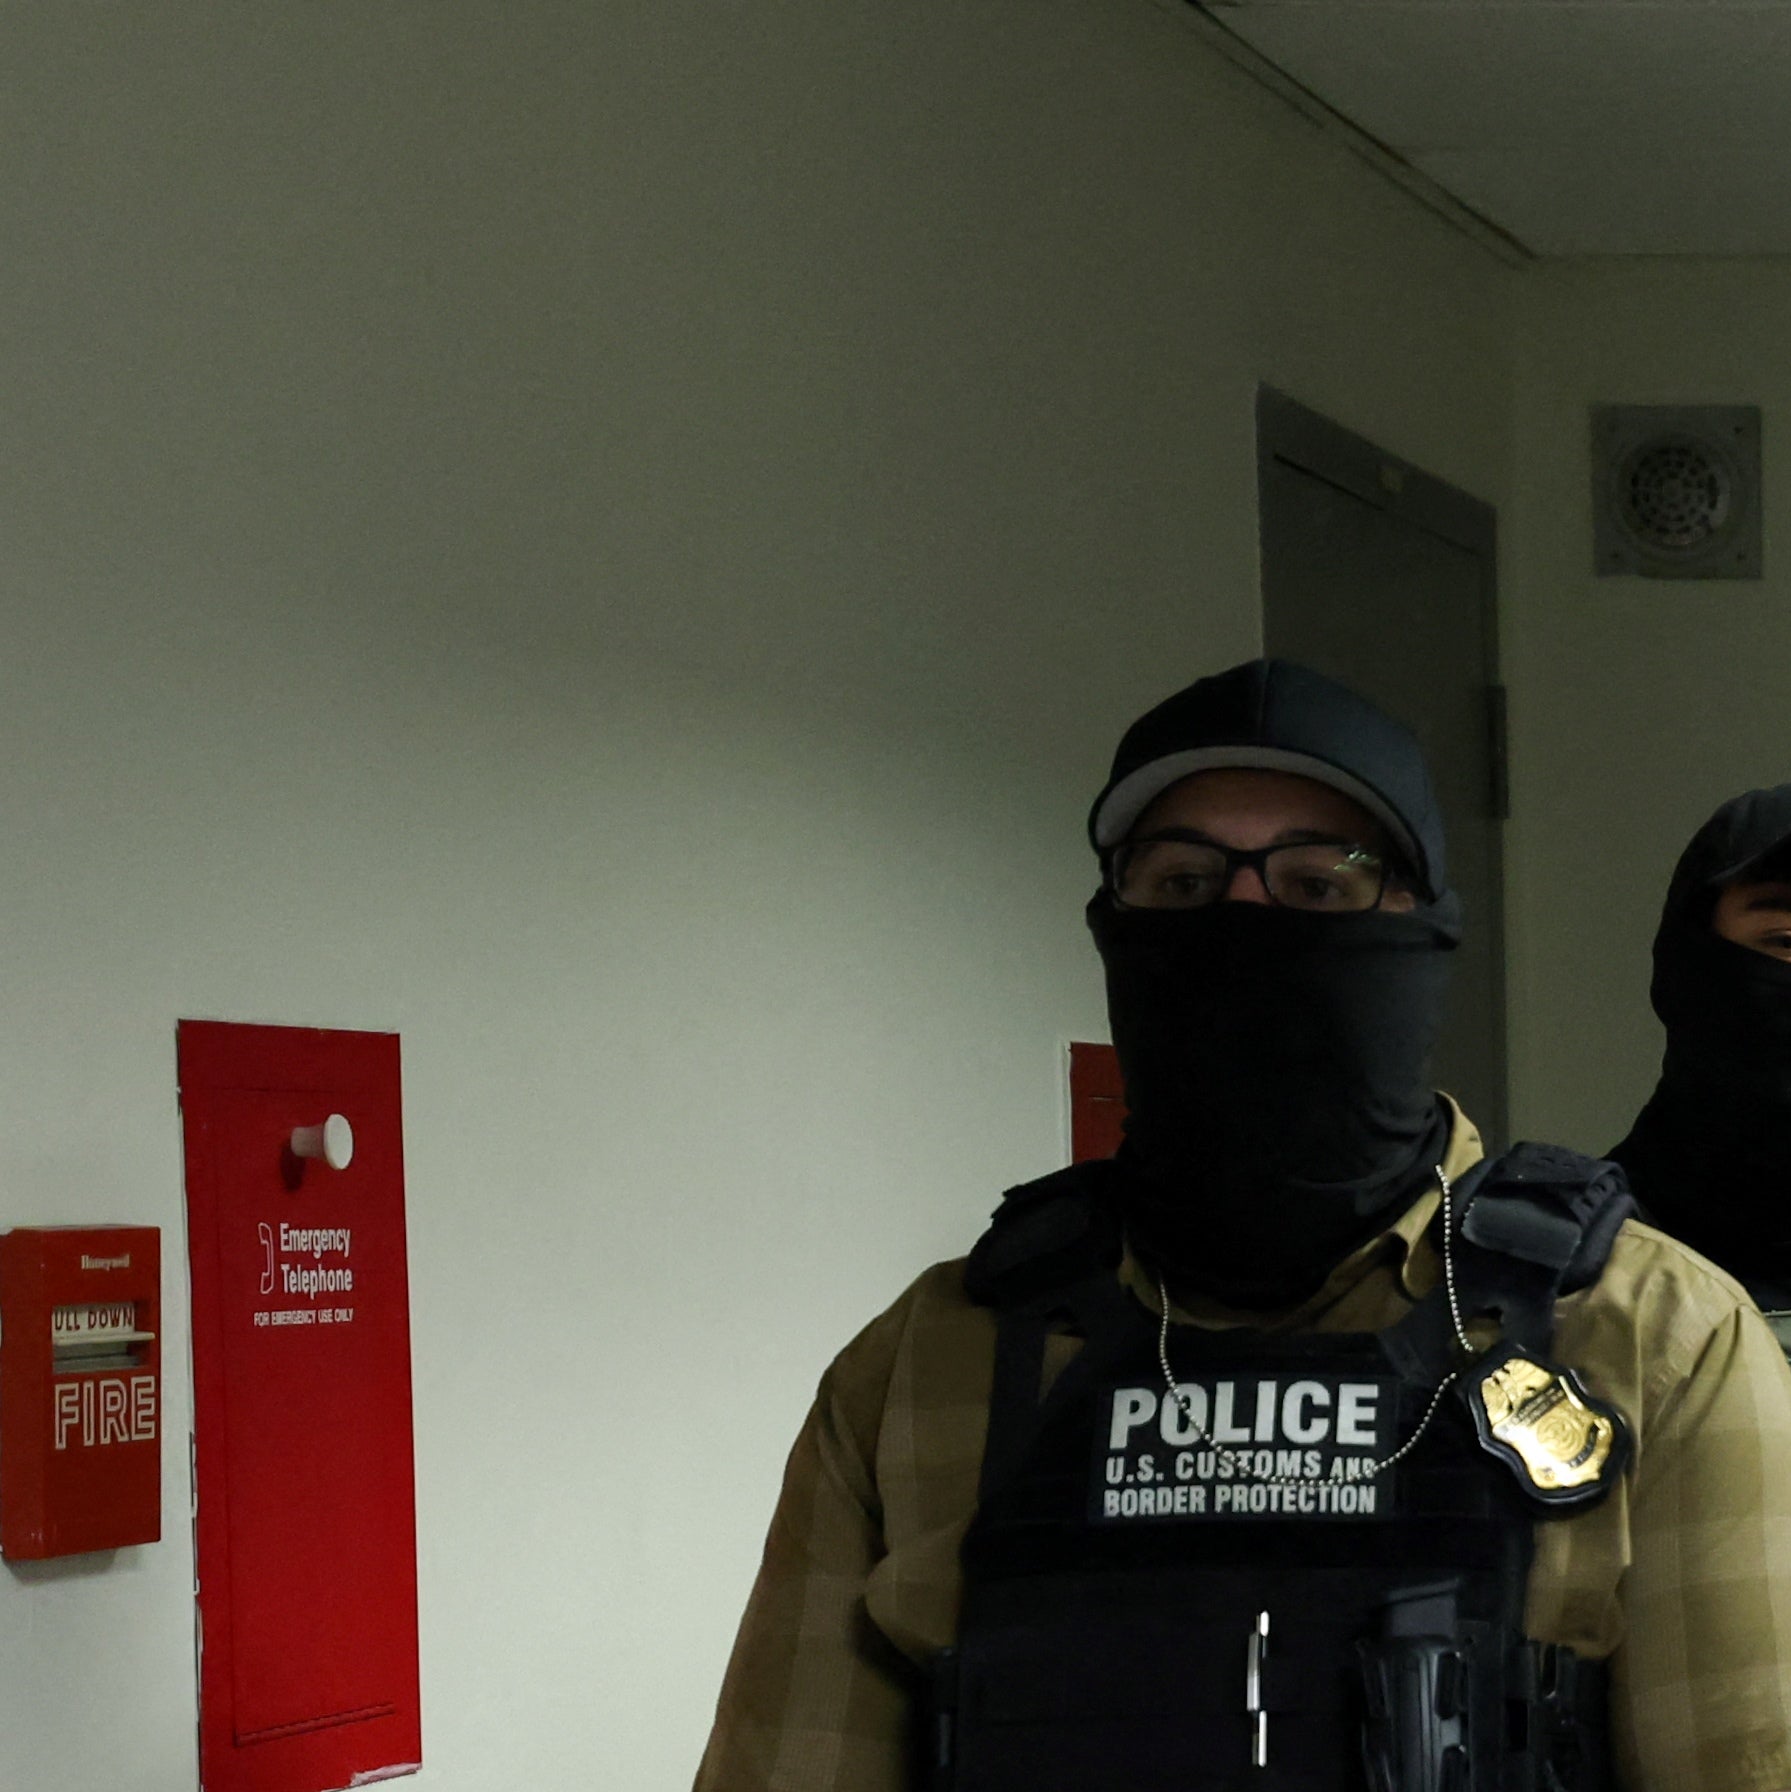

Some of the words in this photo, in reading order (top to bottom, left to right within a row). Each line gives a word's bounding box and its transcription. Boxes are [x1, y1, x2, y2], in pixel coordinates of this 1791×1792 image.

[280, 1222, 351, 1259] Emergency
[281, 1263, 353, 1300] Telephone
[54, 1309, 81, 1331] ULL
[88, 1307, 133, 1330] DOWN
[254, 1311, 270, 1327] FOR
[271, 1309, 316, 1326] EMERGENCY
[318, 1308, 334, 1324] USE
[335, 1307, 354, 1323] ONLY
[54, 1375, 156, 1450] FIRE
[1109, 1379, 1380, 1450] POLICE
[1106, 1453, 1165, 1483] U.S.
[1175, 1449, 1321, 1481] CUSTOMS
[1331, 1456, 1377, 1480] AND
[1104, 1486, 1207, 1518] BORDER
[1213, 1484, 1377, 1515] PROTECTION
